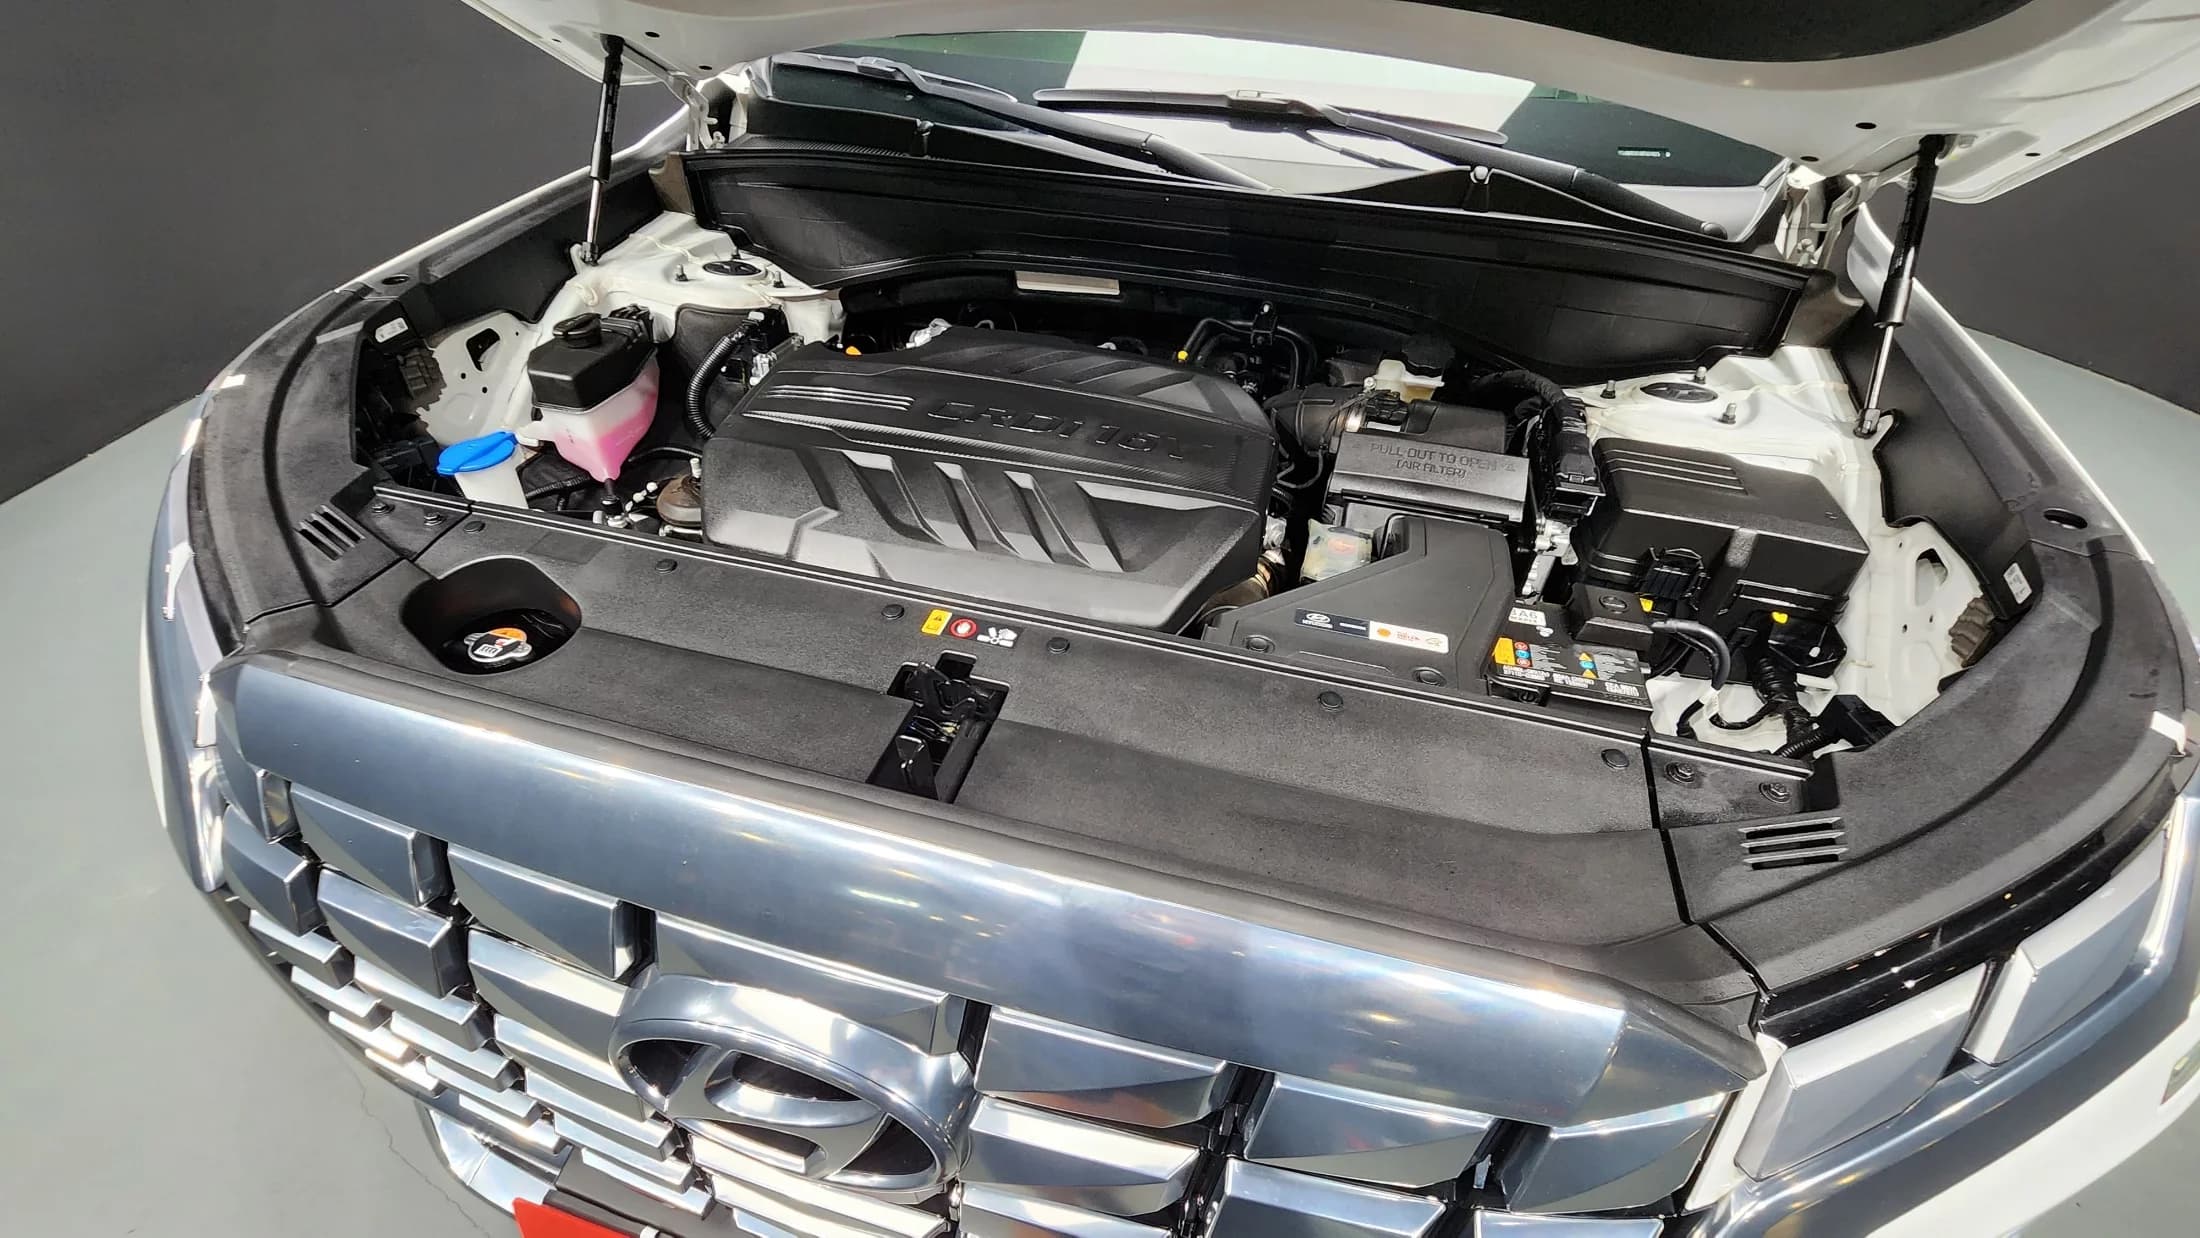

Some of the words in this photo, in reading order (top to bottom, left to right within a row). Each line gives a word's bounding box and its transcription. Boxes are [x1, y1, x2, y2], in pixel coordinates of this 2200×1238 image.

[1370, 443, 1403, 457] PULL
[1407, 448, 1436, 460] OUT
[1439, 452, 1456, 463] TO
[1460, 455, 1497, 471] OPEN
